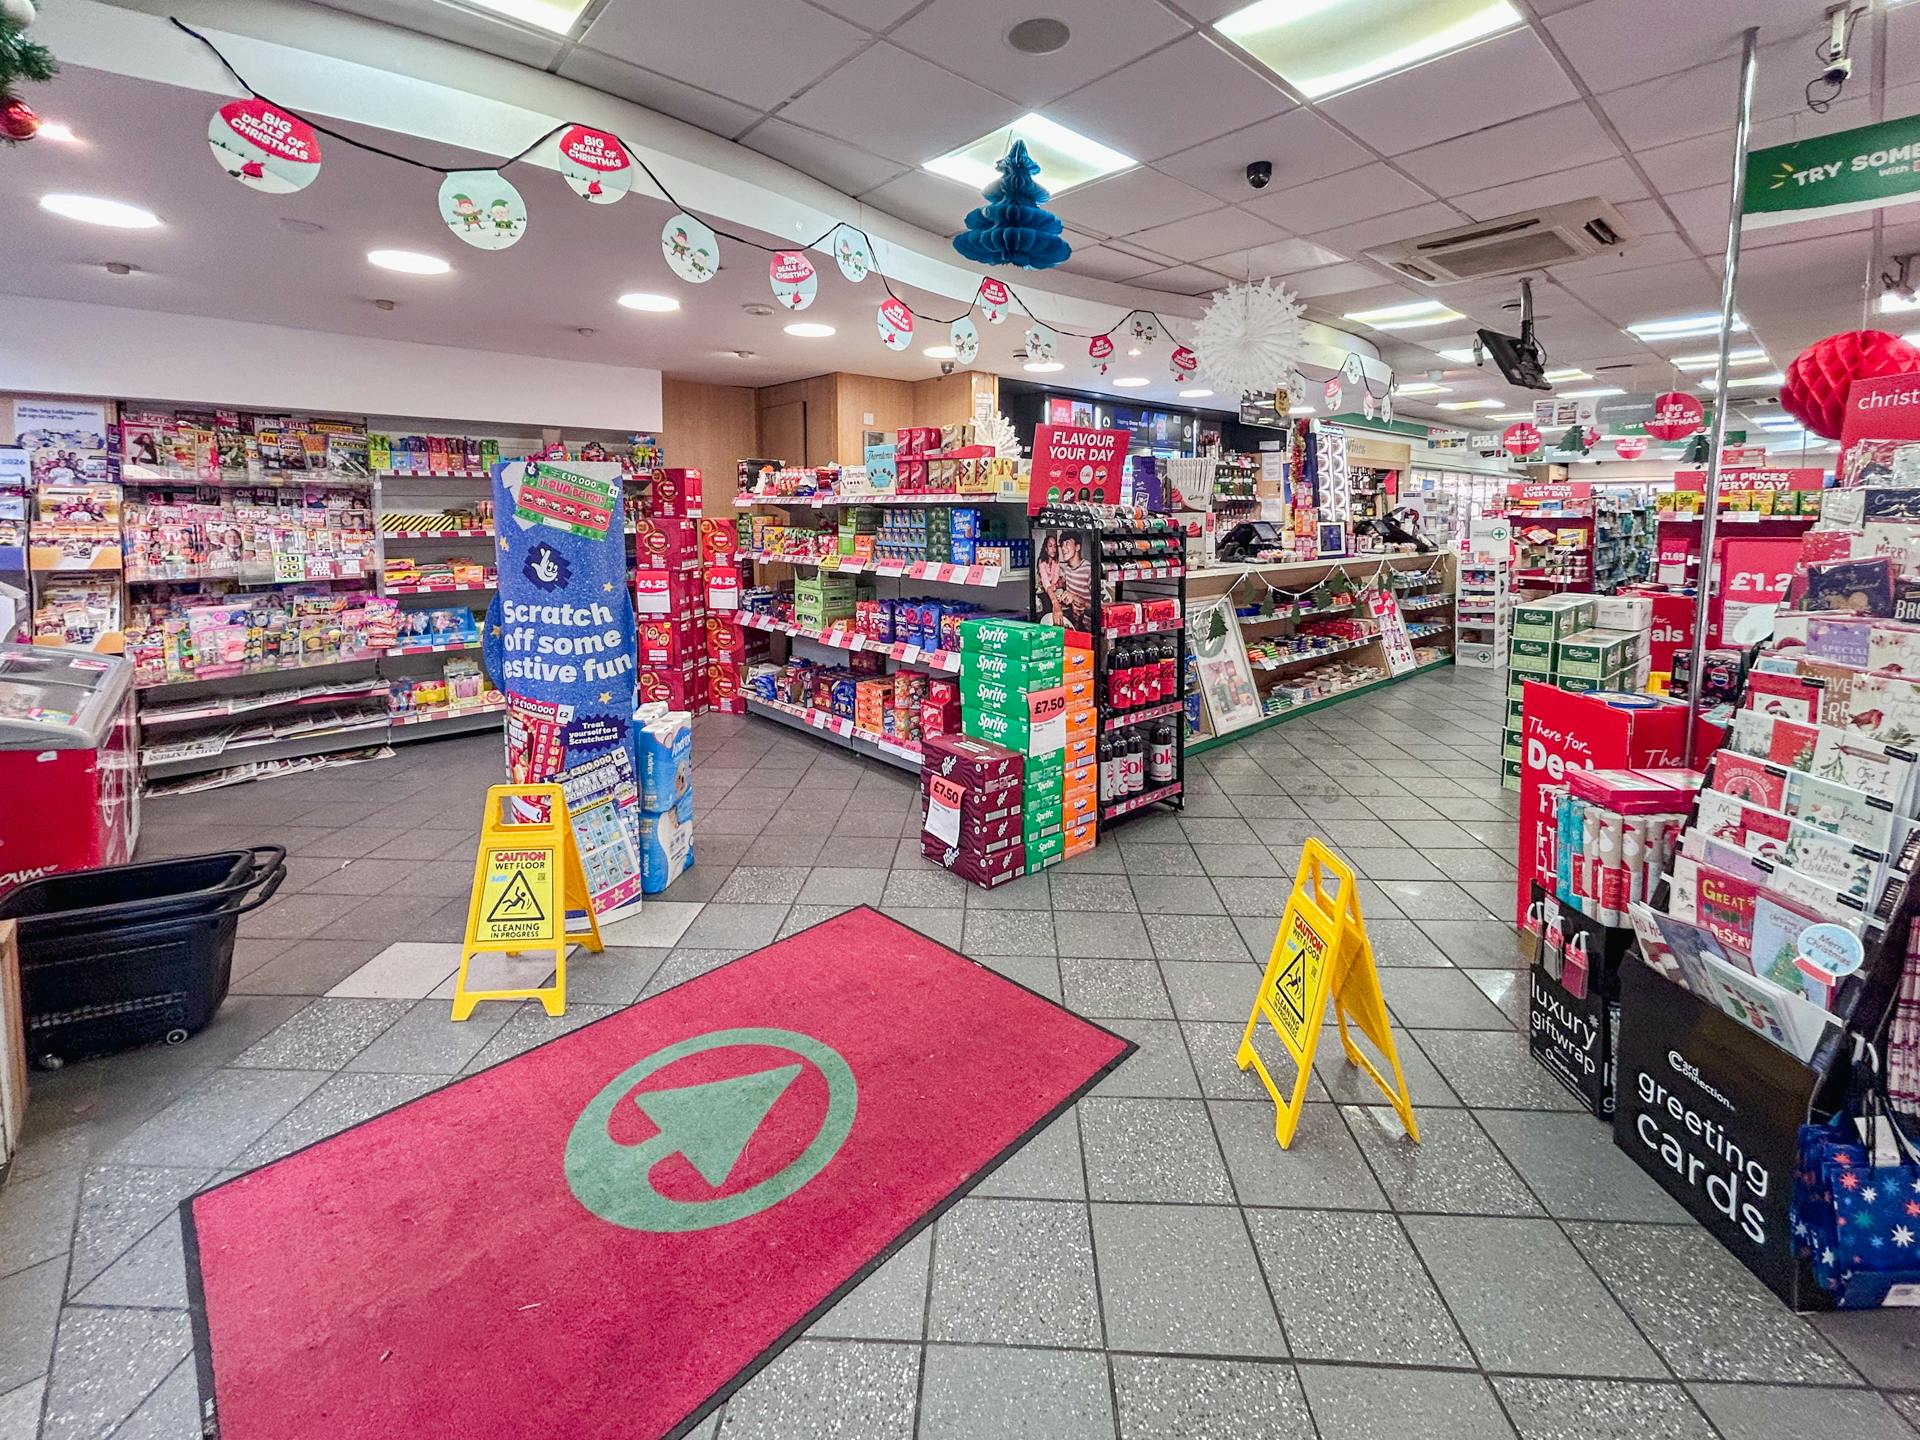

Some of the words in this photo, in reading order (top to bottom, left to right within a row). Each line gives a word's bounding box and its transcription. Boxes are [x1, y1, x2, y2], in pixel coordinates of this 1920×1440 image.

[241, 113, 285, 139] DEALS
[287, 136, 305, 149] OF
[262, 112, 292, 133] BIG
[231, 117, 308, 160] CHRISTMAS
[584, 135, 604, 149] BIG
[568, 149, 622, 167] CHRISTMAS
[572, 142, 602, 156] DEALS
[604, 150, 616, 158] OF
[1793, 161, 1843, 186] TRY
[1879, 165, 1910, 177] with
[784, 256, 797, 265] BIG
[776, 269, 810, 279] CHRISTMAS
[888, 307, 902, 319] DEALS
[894, 304, 904, 315] BIG
[884, 310, 909, 331] CHRISTMAS
[1053, 431, 1114, 447] FLAVOUR
[1049, 447, 1085, 460] YOUR
[1089, 449, 1114, 461] DAY
[1706, 473, 1735, 482] OW
[1740, 472, 1788, 482] PRICES
[1754, 481, 1790, 490] DAY!
[609, 488, 617, 496] £1
[237, 509, 267, 518] Chat
[639, 579, 667, 588] £4.25
[711, 576, 736, 585] £4.25
[503, 600, 613, 626] Scratch
[504, 627, 535, 651] off
[537, 630, 622, 655] some
[977, 625, 1008, 643] Sprite
[1040, 631, 1056, 640] Sprite
[1652, 625, 1684, 643] als
[503, 656, 578, 683] estive
[582, 653, 633, 682] fun
[976, 655, 1007, 673] Sprite
[1038, 661, 1055, 671] Sprite
[977, 684, 1007, 703] Sprite
[1035, 697, 1064, 714] £7.50
[582, 721, 604, 729] Treat
[978, 713, 1008, 733] Sprite
[569, 727, 601, 739] yourself
[569, 732, 618, 745] Scratchcard
[1528, 716, 1562, 742] There
[1564, 732, 1592, 756] for...
[615, 752, 625, 761] £3
[934, 781, 958, 804] £7.50
[1037, 780, 1054, 791] Sprite
[1036, 810, 1053, 822] Sprite
[1039, 840, 1056, 852] Sprite
[495, 851, 546, 862] CAUTION
[1702, 879, 1745, 911] GREAT
[491, 923, 540, 932] CLEANING
[1294, 916, 1324, 955] CAUTION
[1293, 928, 1303, 943] WET
[1303, 940, 1320, 962] FLOOR
[1806, 937, 1851, 966] Christmas
[1275, 992, 1300, 1030] CLEANING
[1531, 972, 1597, 1051] luxury
[1532, 1010, 1596, 1075] giftwrap
[1668, 1050, 1699, 1076] Card
[1638, 1072, 1768, 1198] greeting
[1637, 1113, 1766, 1244] cards
